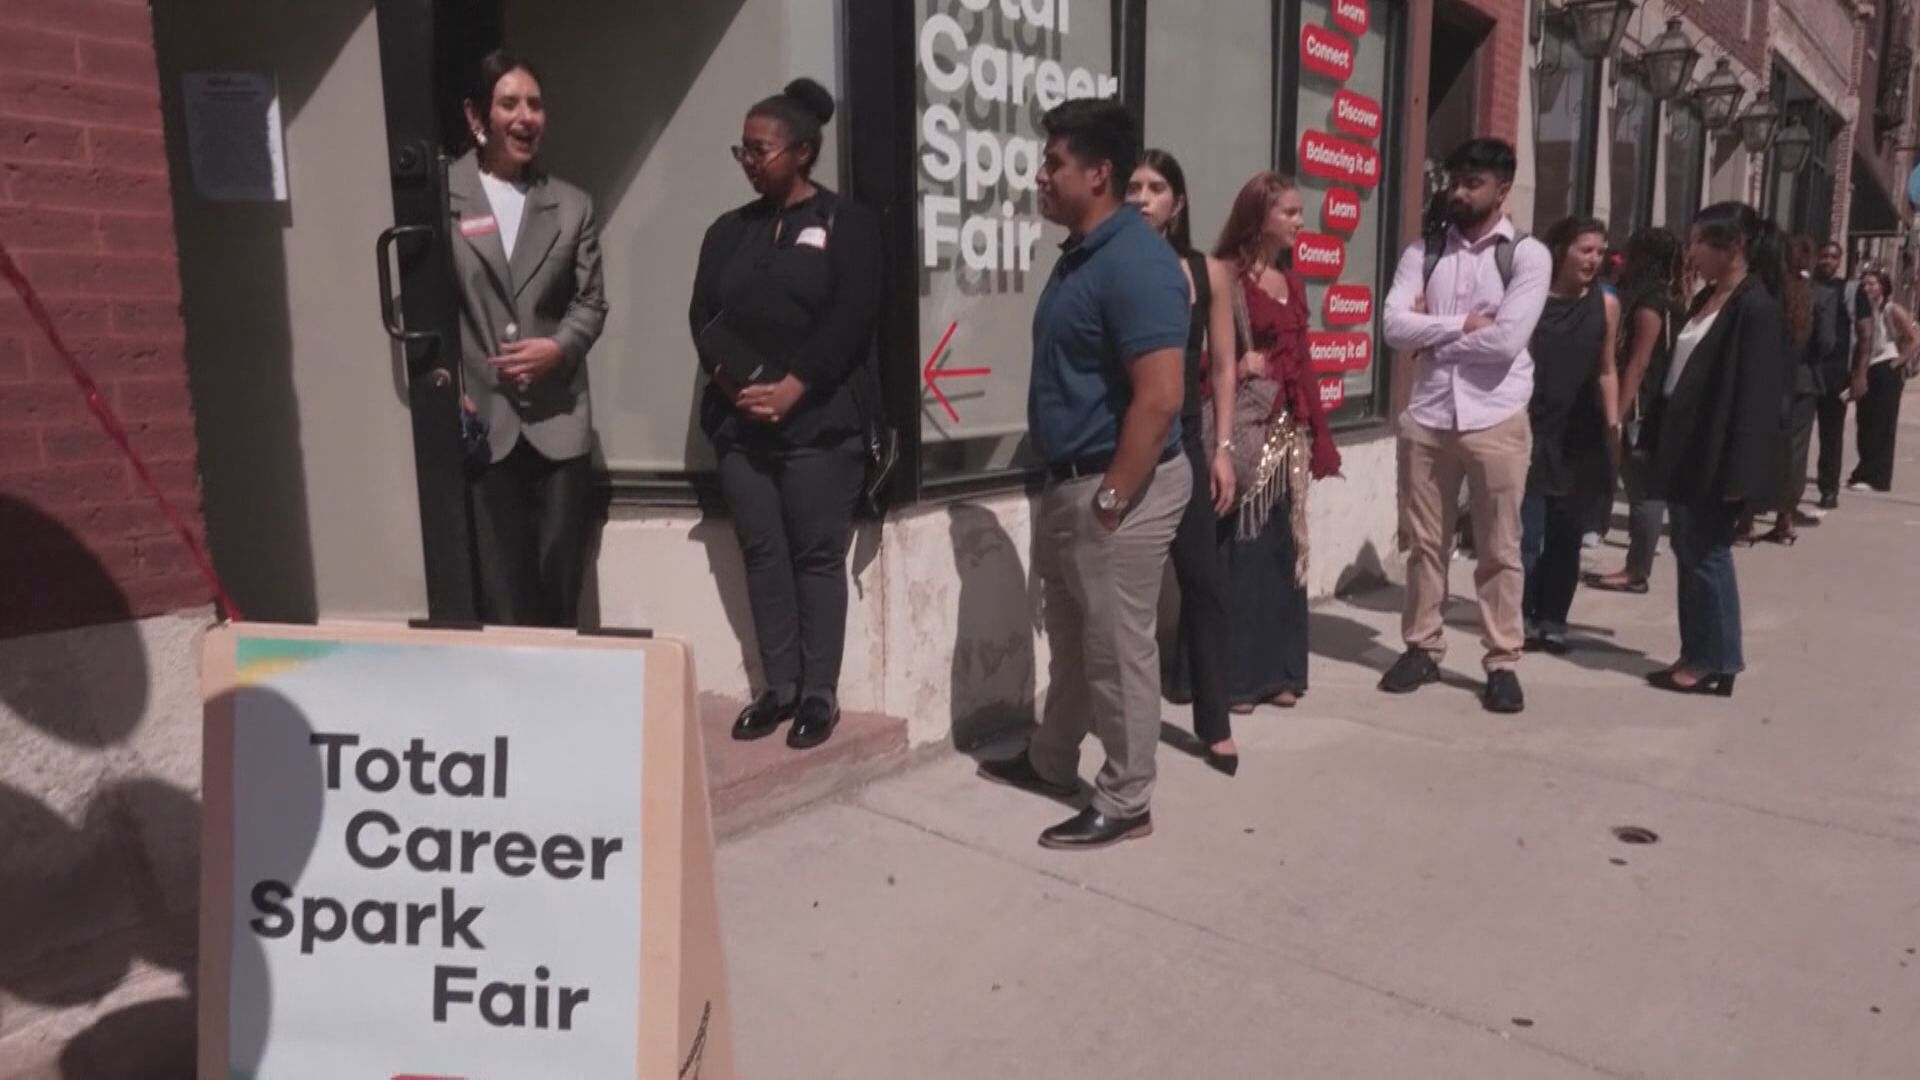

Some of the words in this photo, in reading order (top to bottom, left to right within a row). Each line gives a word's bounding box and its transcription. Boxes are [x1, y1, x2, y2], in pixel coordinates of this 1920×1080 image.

[1306, 34, 1349, 69] Connect
[1338, 98, 1378, 128] Discover
[922, 104, 1046, 200] Spa
[1306, 140, 1355, 174] Balancing
[1356, 153, 1363, 173] it
[1364, 157, 1376, 176] all
[1328, 196, 1357, 219] Learn
[923, 194, 1042, 272] Fair
[1298, 241, 1340, 265] Connect
[1329, 294, 1368, 313] Discover
[1346, 341, 1355, 359] it
[1355, 341, 1367, 358] all
[310, 733, 508, 798] Total
[345, 809, 623, 880] Career
[249, 879, 486, 955] Spark
[433, 965, 590, 1031] Fair
